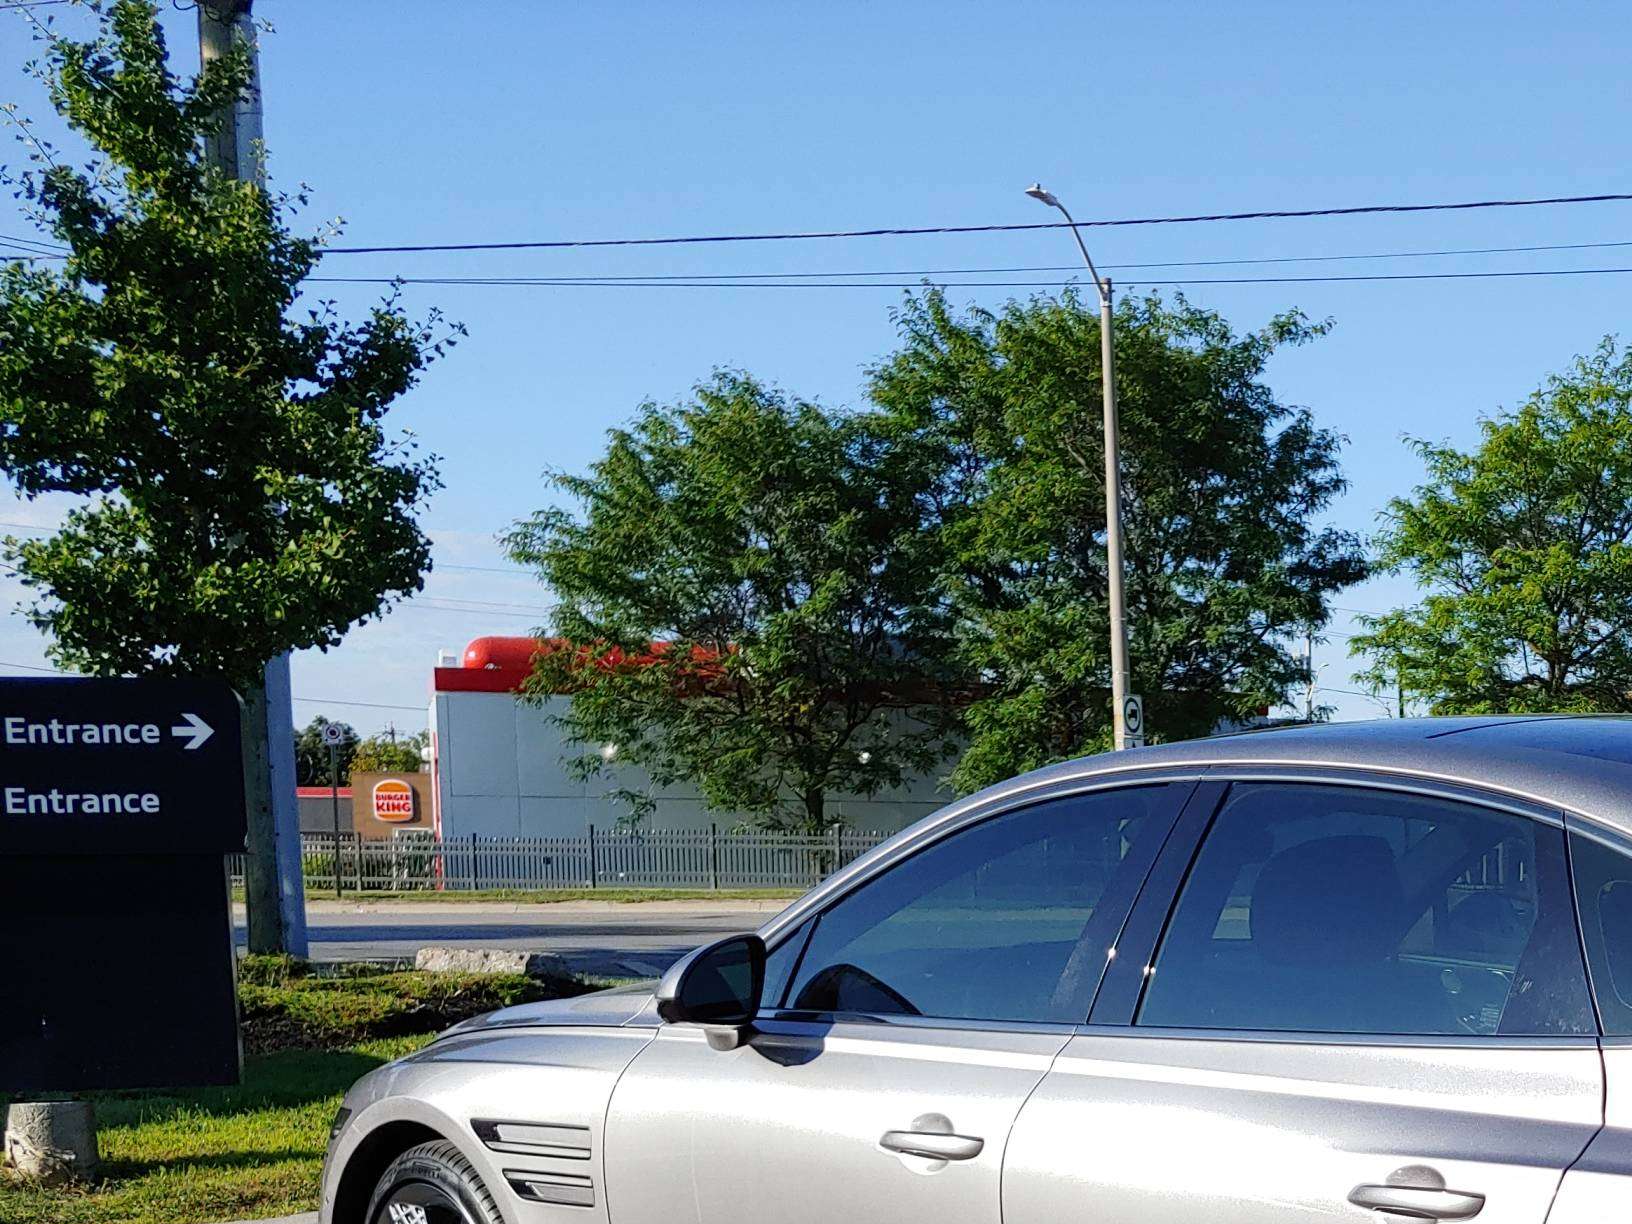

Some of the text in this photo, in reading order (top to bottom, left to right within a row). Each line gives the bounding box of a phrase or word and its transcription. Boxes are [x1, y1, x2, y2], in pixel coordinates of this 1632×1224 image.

[4, 717, 160, 744] Entrance
[4, 787, 160, 814] Entrance
[376, 802, 411, 812] KING
